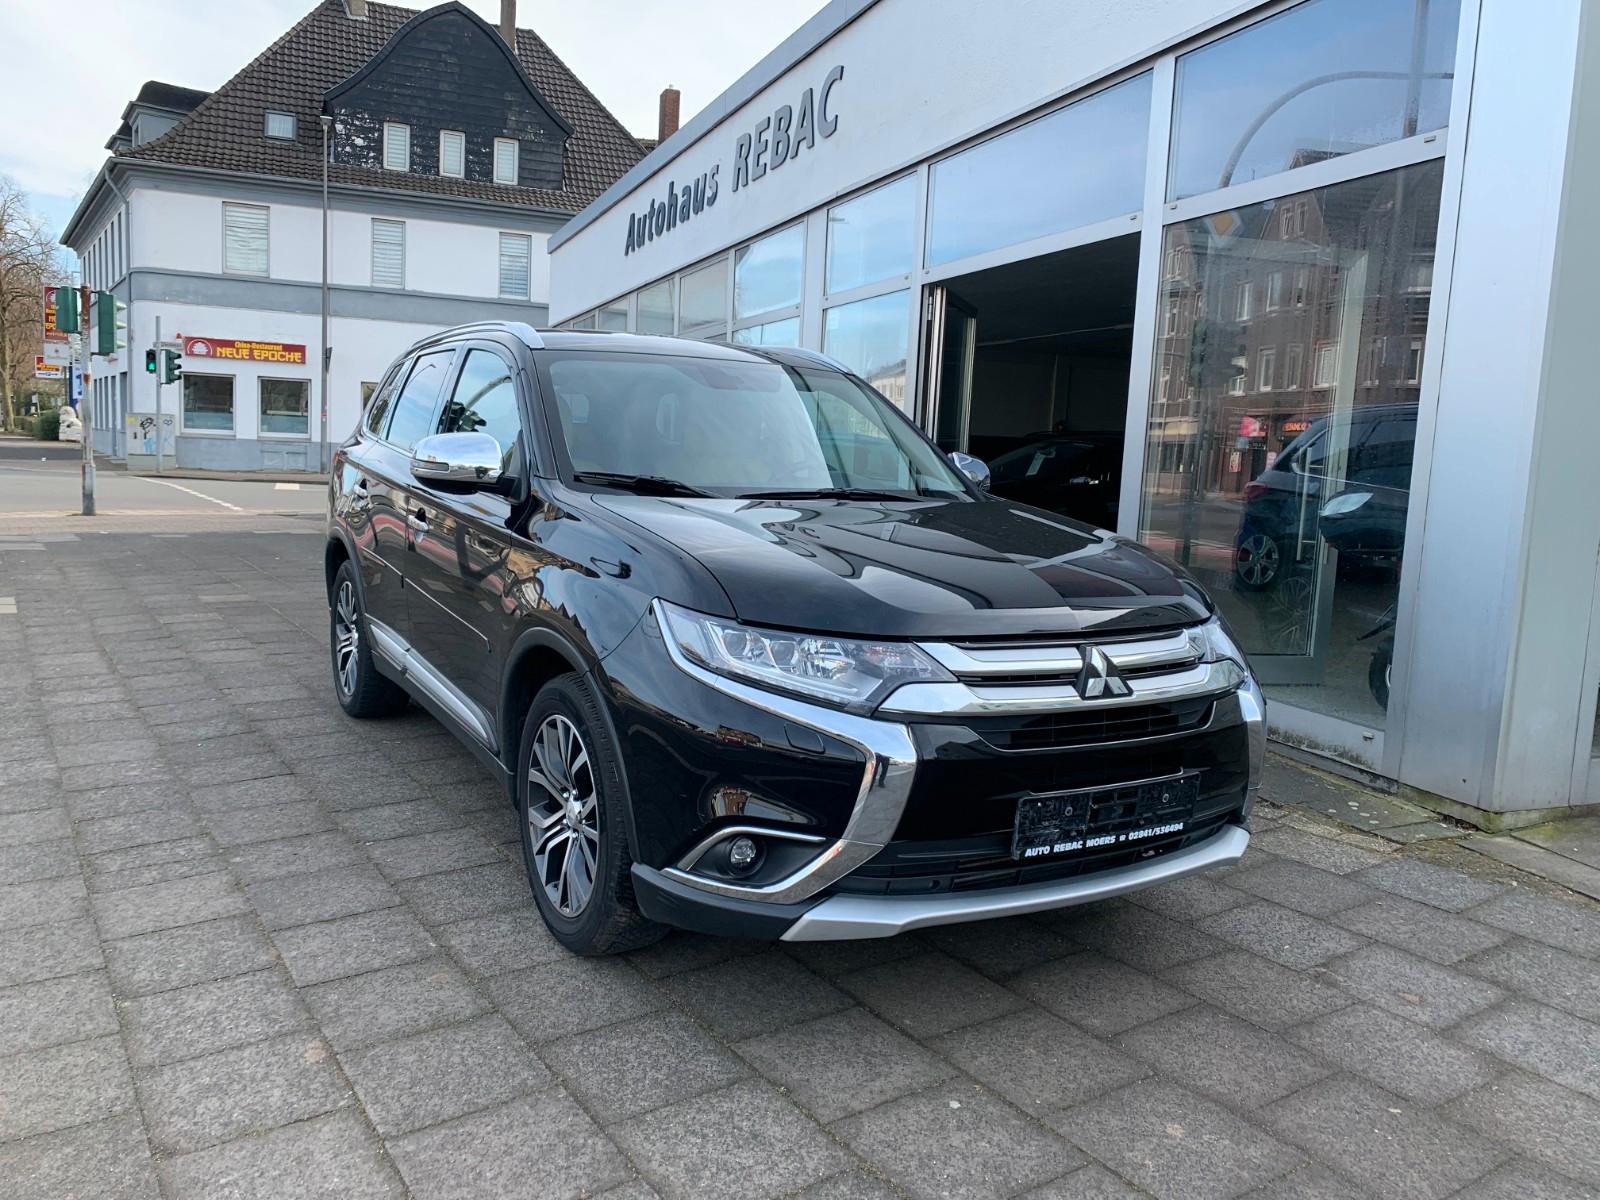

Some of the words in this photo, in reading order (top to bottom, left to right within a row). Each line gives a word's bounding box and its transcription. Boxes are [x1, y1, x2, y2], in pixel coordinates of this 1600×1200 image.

[624, 164, 719, 256] Autohaus
[732, 65, 844, 192] REBAC
[216, 347, 250, 360] NEUE
[253, 350, 302, 363] EPOCHE
[1024, 845, 1051, 858] AUTO
[1053, 839, 1084, 853] REBAC
[1085, 834, 1116, 848] MOERS
